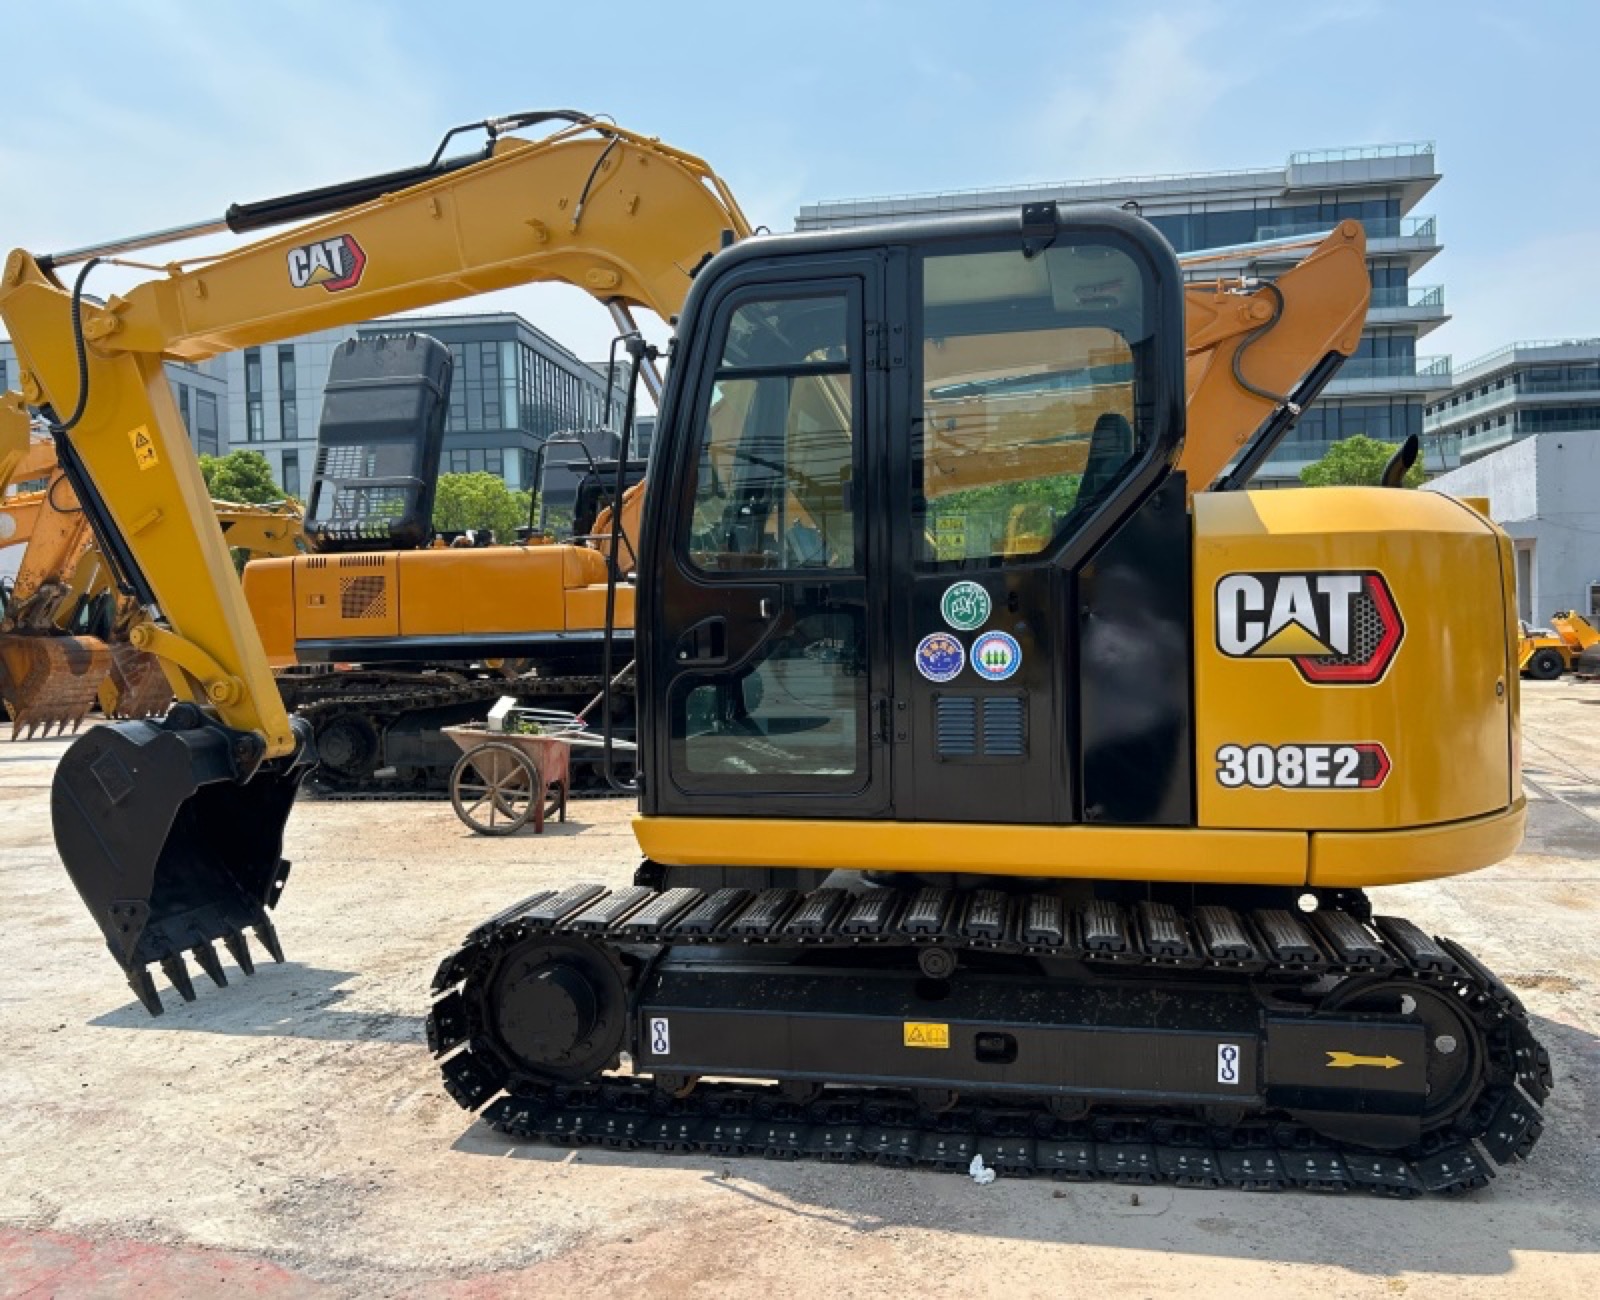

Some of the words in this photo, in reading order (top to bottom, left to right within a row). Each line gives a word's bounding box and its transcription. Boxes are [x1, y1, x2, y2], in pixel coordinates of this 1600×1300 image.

[288, 238, 343, 287] CAT
[1217, 575, 1362, 655] CAT
[1217, 745, 1360, 786] 308E2
